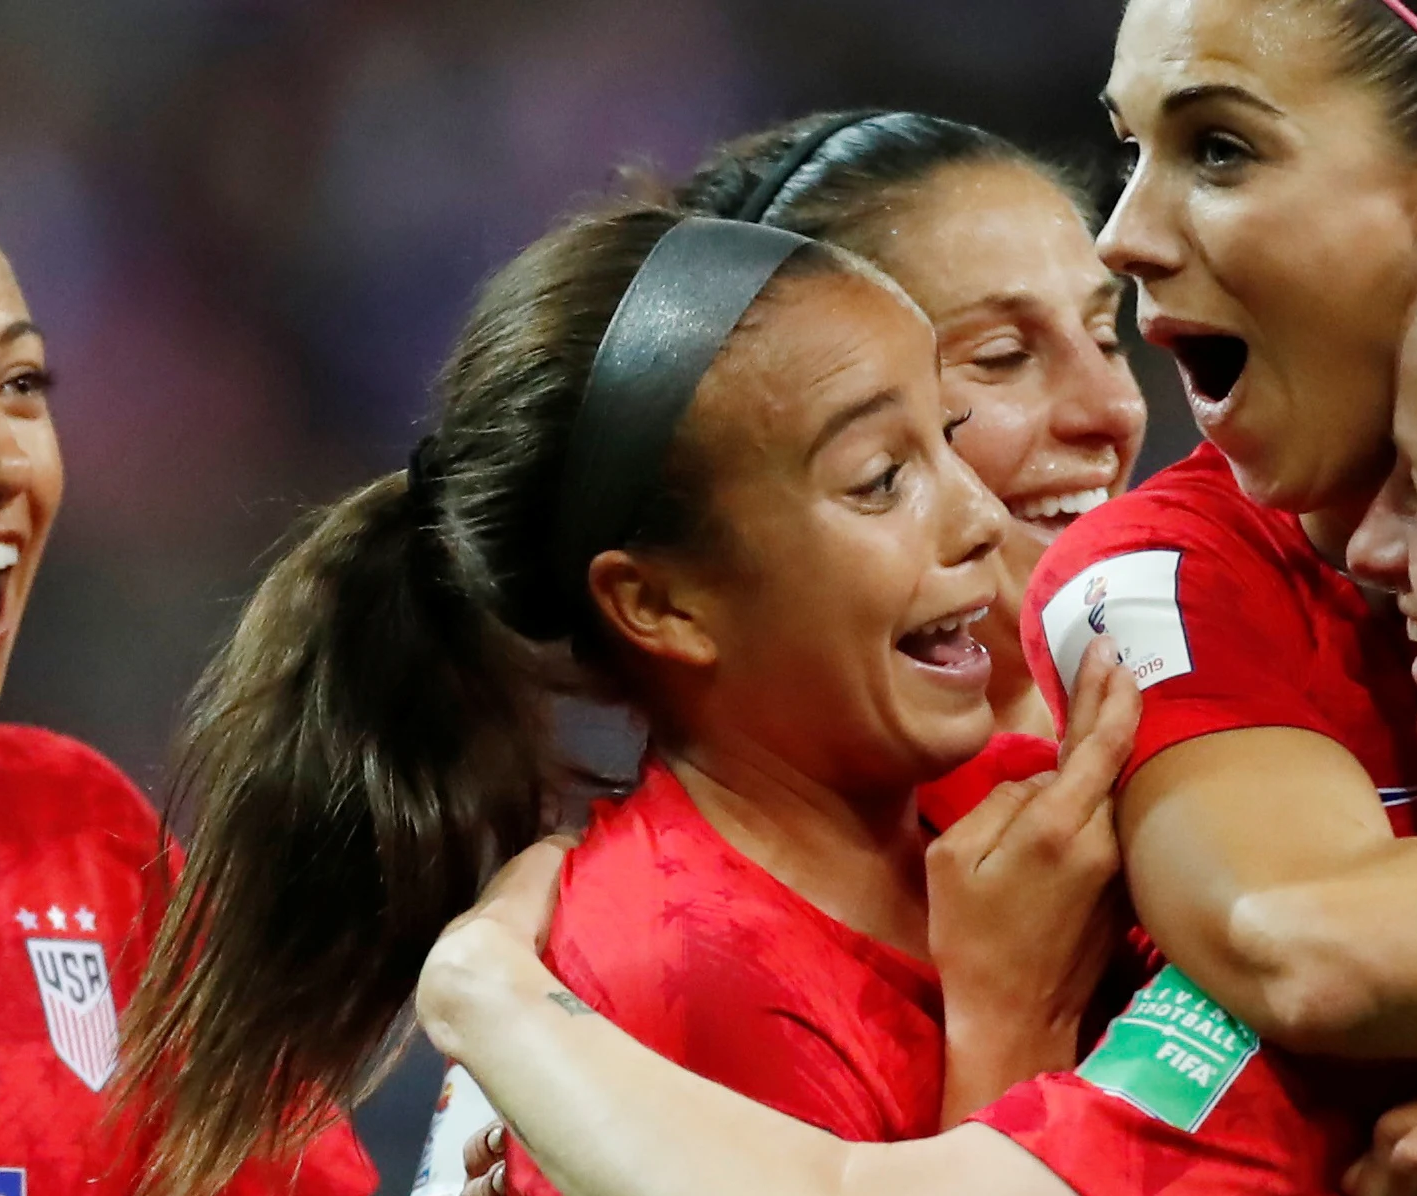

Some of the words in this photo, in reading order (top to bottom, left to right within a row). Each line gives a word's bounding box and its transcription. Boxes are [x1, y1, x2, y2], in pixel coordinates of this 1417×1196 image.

[1133, 657, 1163, 679] 019
[37, 951, 101, 1004] USA
[1134, 1001, 1237, 1052] FOOTBALL
[1156, 1041, 1213, 1087] FIFA
